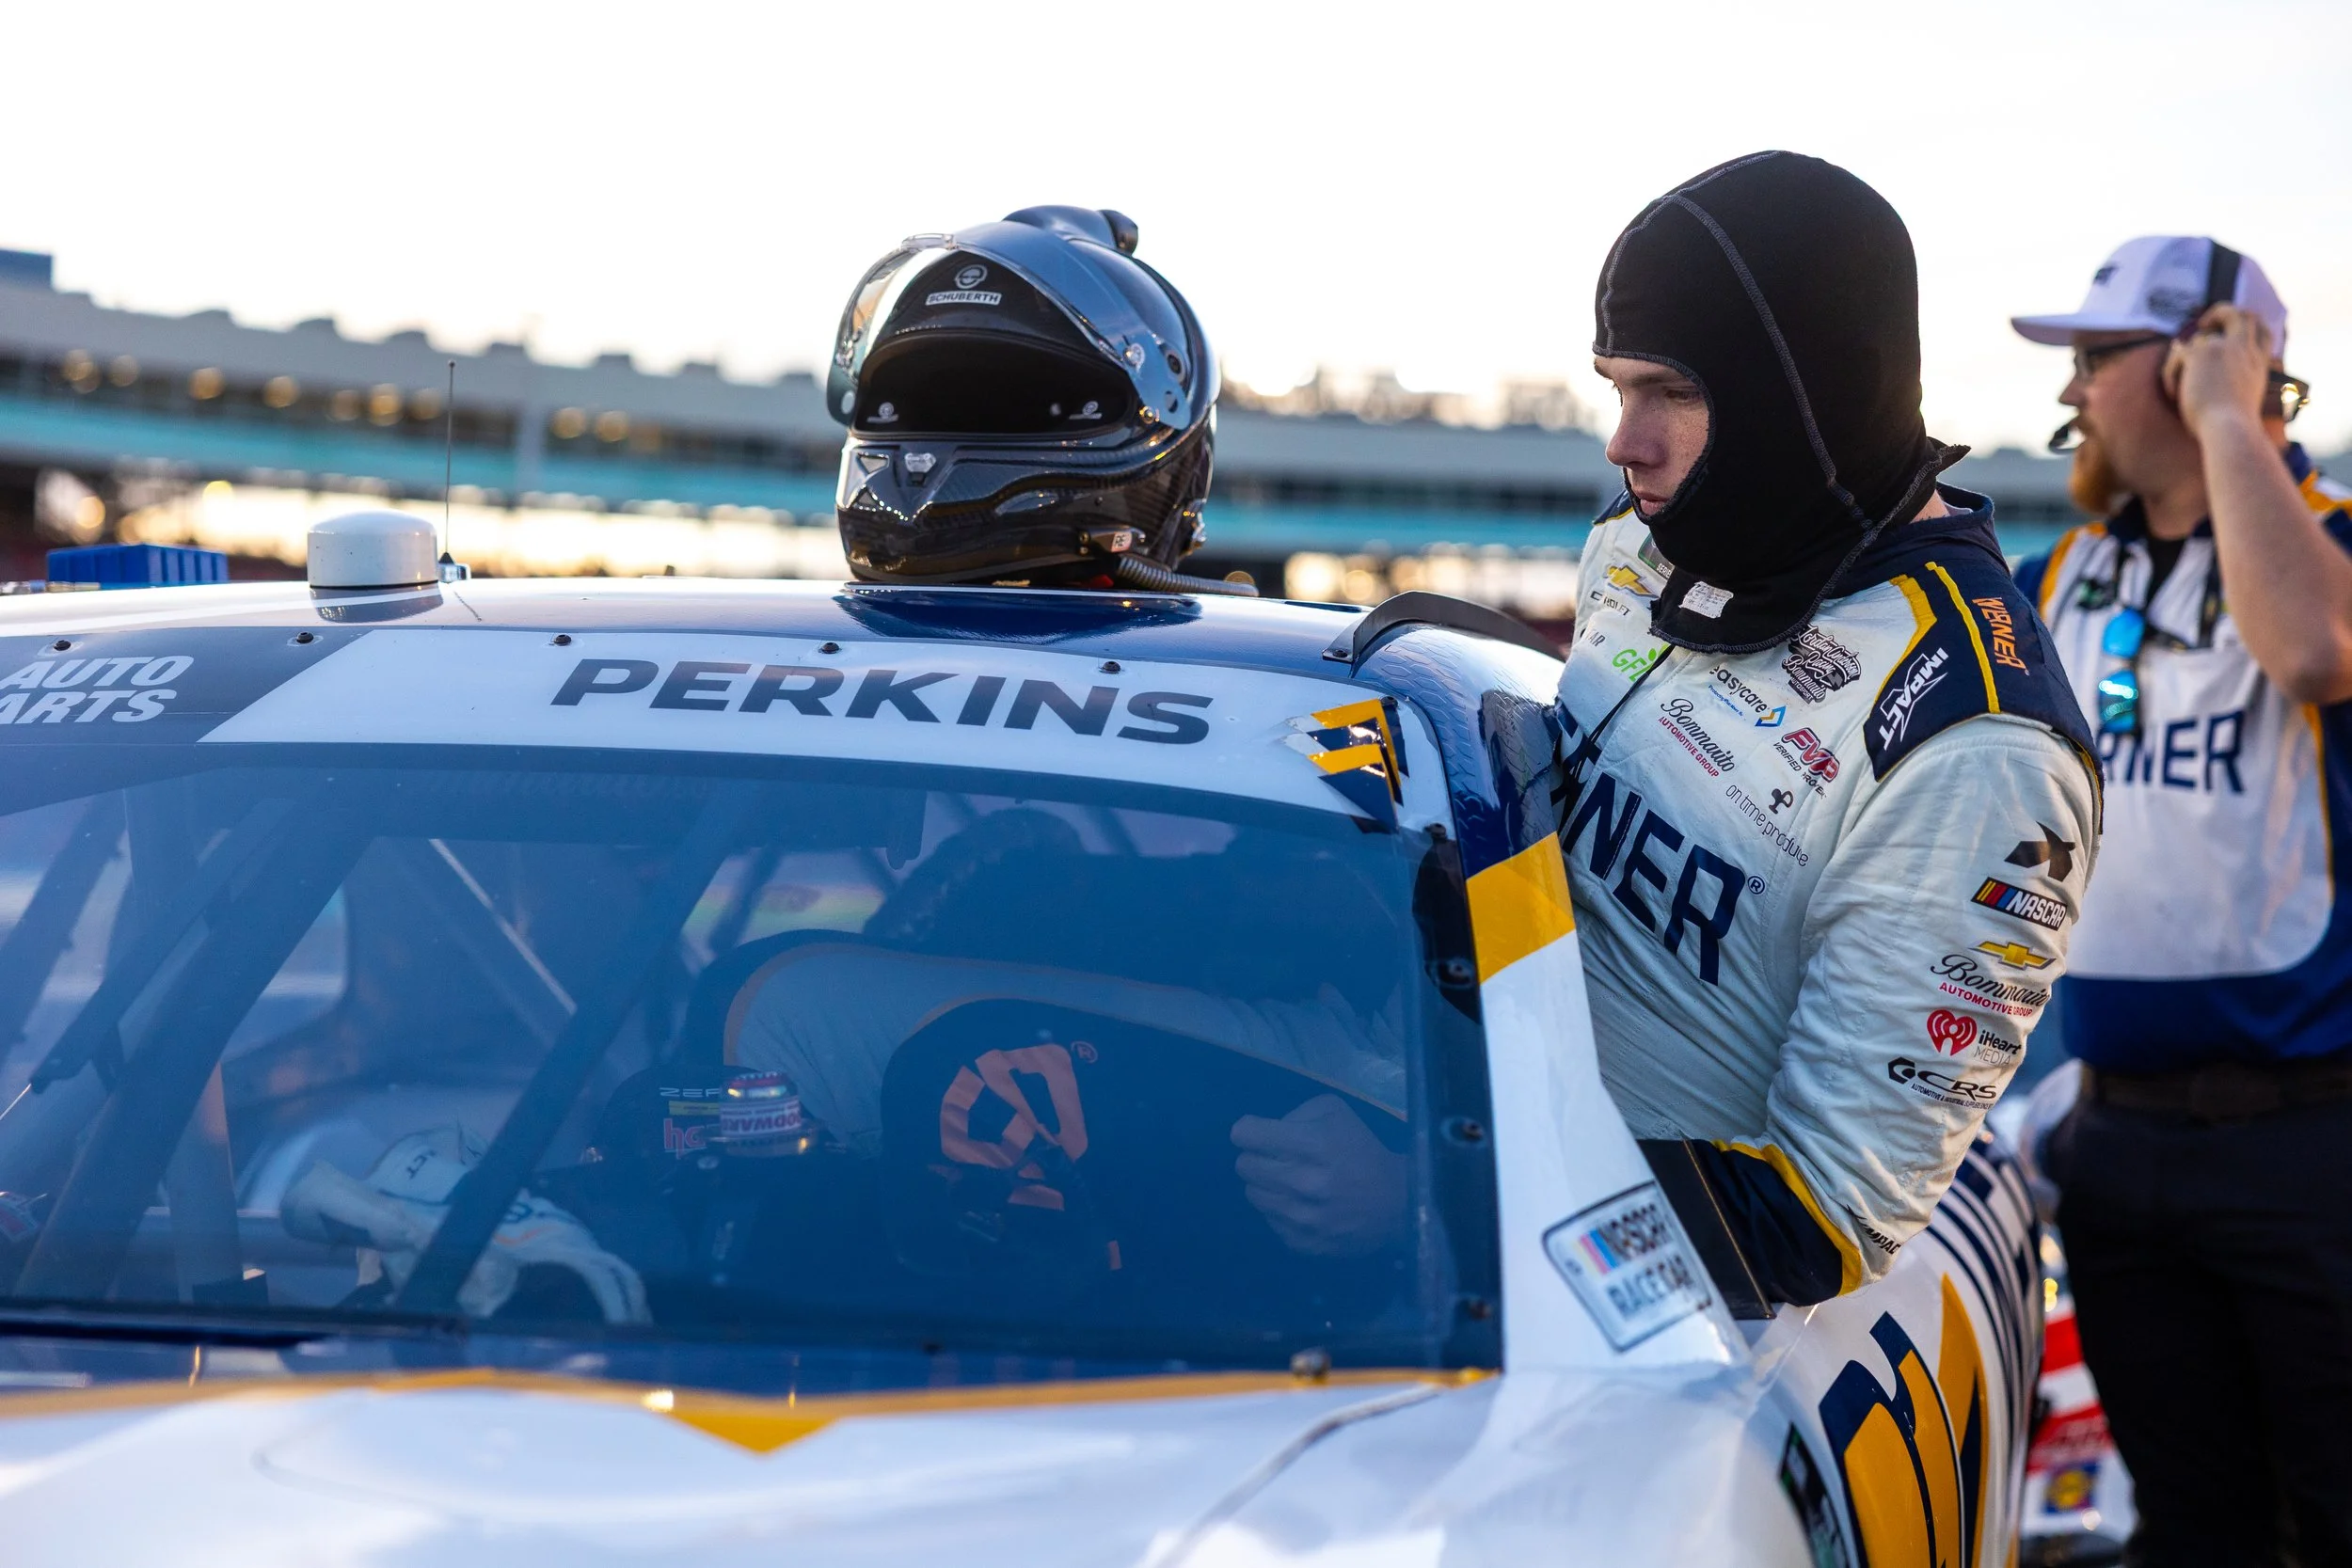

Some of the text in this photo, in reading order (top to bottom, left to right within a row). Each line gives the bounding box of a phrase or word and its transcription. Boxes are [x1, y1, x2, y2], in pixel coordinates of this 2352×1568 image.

[929, 292, 999, 303] SCHUBERTH
[1972, 596, 2026, 671] WERNER
[0, 656, 194, 689] AUTO
[0, 689, 177, 724] ARTS
[550, 659, 1214, 744] PERKINS
[1879, 647, 1949, 751] IMPACT
[1659, 716, 1720, 778] AUTOMOTIVE GROUP
[1661, 698, 1735, 772] Bommarito
[2097, 710, 2246, 794] RNER
[1773, 741, 1802, 771] VERIFIED
[1782, 727, 1840, 783] FVP
[1725, 784, 1742, 803] on
[2006, 891, 2066, 927] NASCAR
[1939, 982, 2013, 1015] AUTOMOTIVE
[1973, 1046, 2011, 1067] MEDIA
[1979, 1030, 2021, 1054] iHeart
